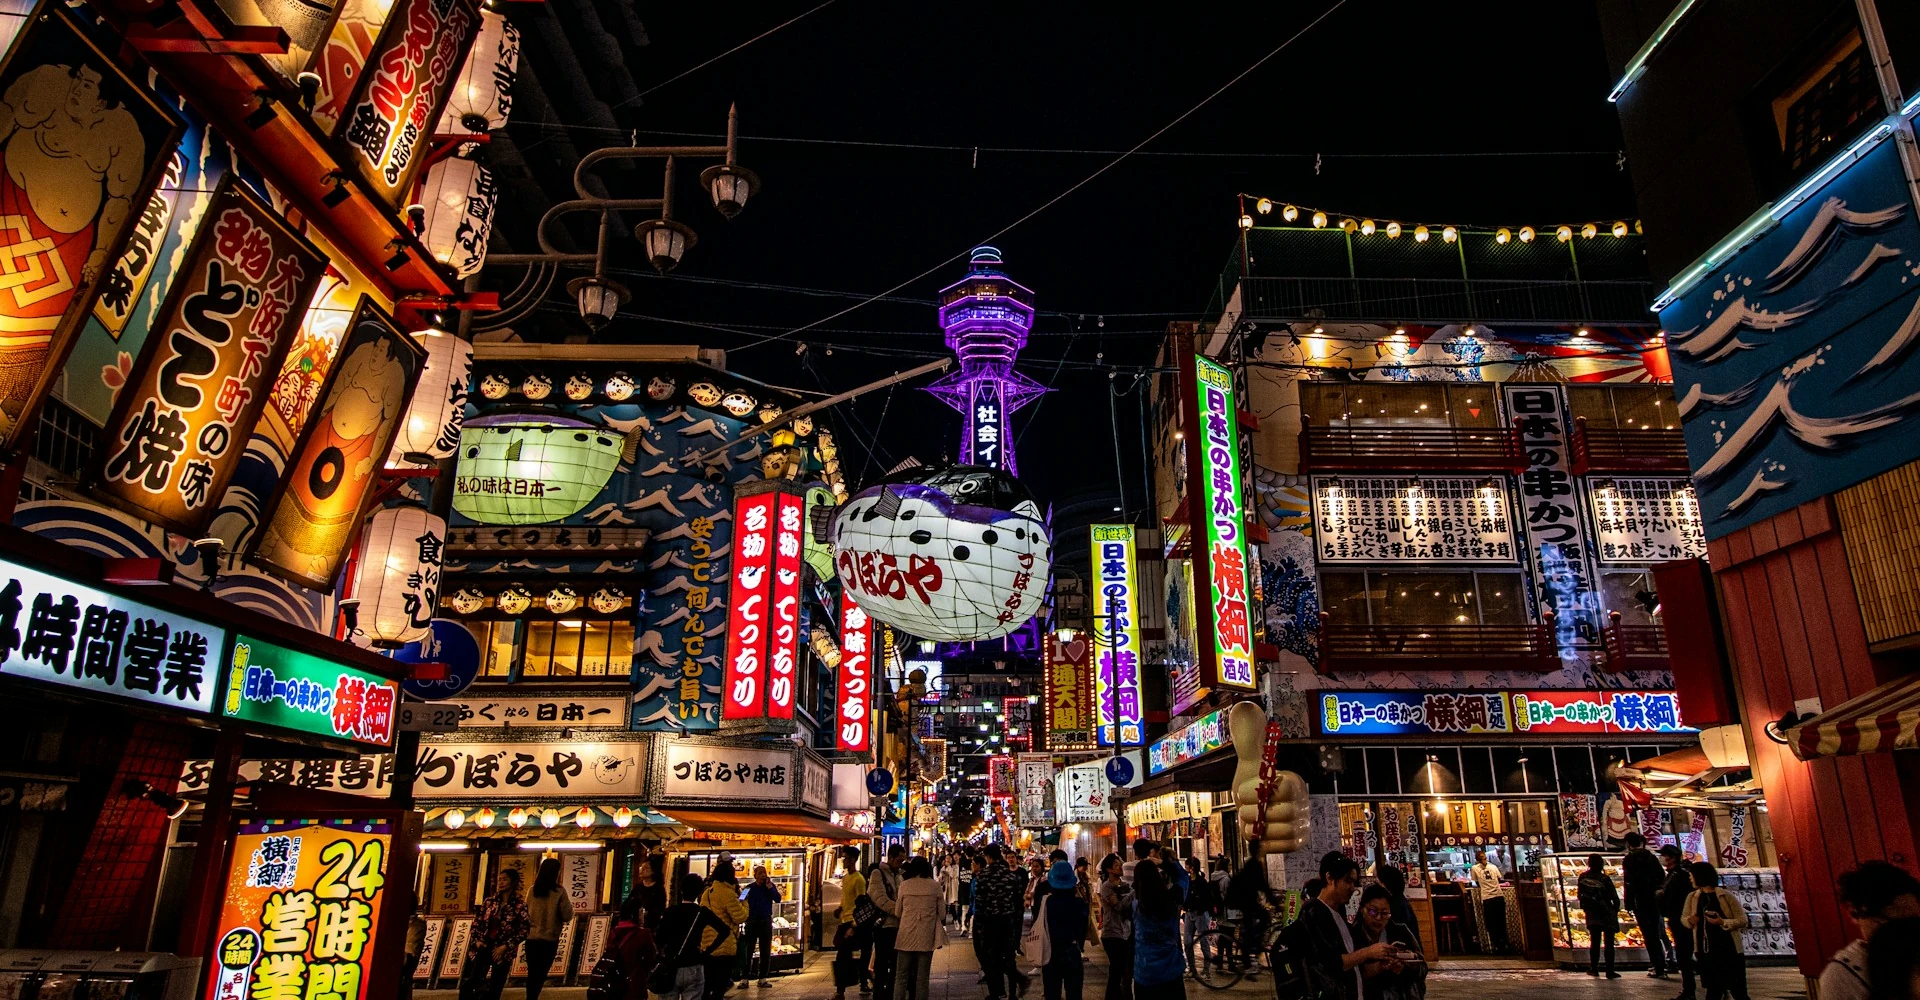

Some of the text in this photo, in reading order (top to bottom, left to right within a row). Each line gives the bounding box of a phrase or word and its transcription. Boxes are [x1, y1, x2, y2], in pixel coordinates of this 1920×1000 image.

[215, 208, 273, 284] 名物
[178, 254, 304, 511] 大阪下町の味
[1198, 361, 1232, 393] 新世界
[977, 405, 1001, 468] 社会イ
[1207, 387, 1237, 541] 日本一の串かつ
[1512, 391, 1578, 543] 日本一の串かつ
[457, 478, 562, 497] 私の味は日本一
[743, 504, 767, 558] 名物
[779, 505, 800, 558] 名物
[1094, 527, 1132, 541] 新世界
[1321, 517, 1335, 558] もち
[1348, 517, 1364, 558] 紅しょうが
[1361, 517, 1375, 558] にんにく
[1374, 517, 1389, 558] 玉ねぎ
[1387, 517, 1403, 558] 山芋
[1401, 517, 1417, 558] しし唐
[1414, 517, 1430, 558] れんこん
[1427, 517, 1443, 558] 銀杏
[1441, 517, 1456, 558] 白ねぎ
[1454, 517, 1470, 558] さつま芋
[1467, 517, 1483, 558] じゃが芋
[1480, 517, 1496, 558] 茄子
[1493, 517, 1510, 558] 椎茸
[1598, 519, 1616, 558] 海老
[1613, 519, 1631, 558] キス
[1626, 519, 1644, 558] 貝柱
[1638, 519, 1656, 558] サーモン
[1651, 519, 1668, 558] たこ
[1664, 519, 1682, 558] いか
[1690, 519, 1708, 558] ホルモン
[839, 547, 943, 606] づぼらや
[1102, 543, 1130, 647] 日本一の串かつ
[1212, 542, 1250, 655] 横綱
[1052, 641, 1066, 662] I
[1223, 657, 1251, 684] 酒処
[227, 644, 250, 714] 新世界
[245, 665, 332, 716] 日本一の串かつ
[1052, 664, 1077, 730] 通天閣
[1077, 664, 1087, 729] TSUTENKAKU
[1100, 651, 1139, 724] 横綱
[331, 675, 395, 742] 横綱
[458, 702, 612, 722] ふぐなら日本一
[1326, 695, 1339, 731] 新世界
[1340, 702, 1423, 725] 日本一の串かつ
[1423, 694, 1488, 731] 横綱
[1488, 695, 1506, 730] 酒処
[1515, 694, 1529, 731] 新世界
[1529, 701, 1613, 724] 日本一の串かつ
[1613, 693, 1675, 730] 横綱
[1105, 726, 1139, 742] 酒処
[415, 747, 583, 789] づぼらや
[673, 759, 786, 787] づぼらや本店
[1642, 808, 1662, 848] 宴会
[257, 837, 291, 887] 横綱
[308, 839, 385, 1000] 24時間
[224, 951, 252, 965] 時間
[226, 934, 254, 949] 24
[251, 891, 317, 1000] 営業
[419, 922, 437, 965] ふぐ天丼
